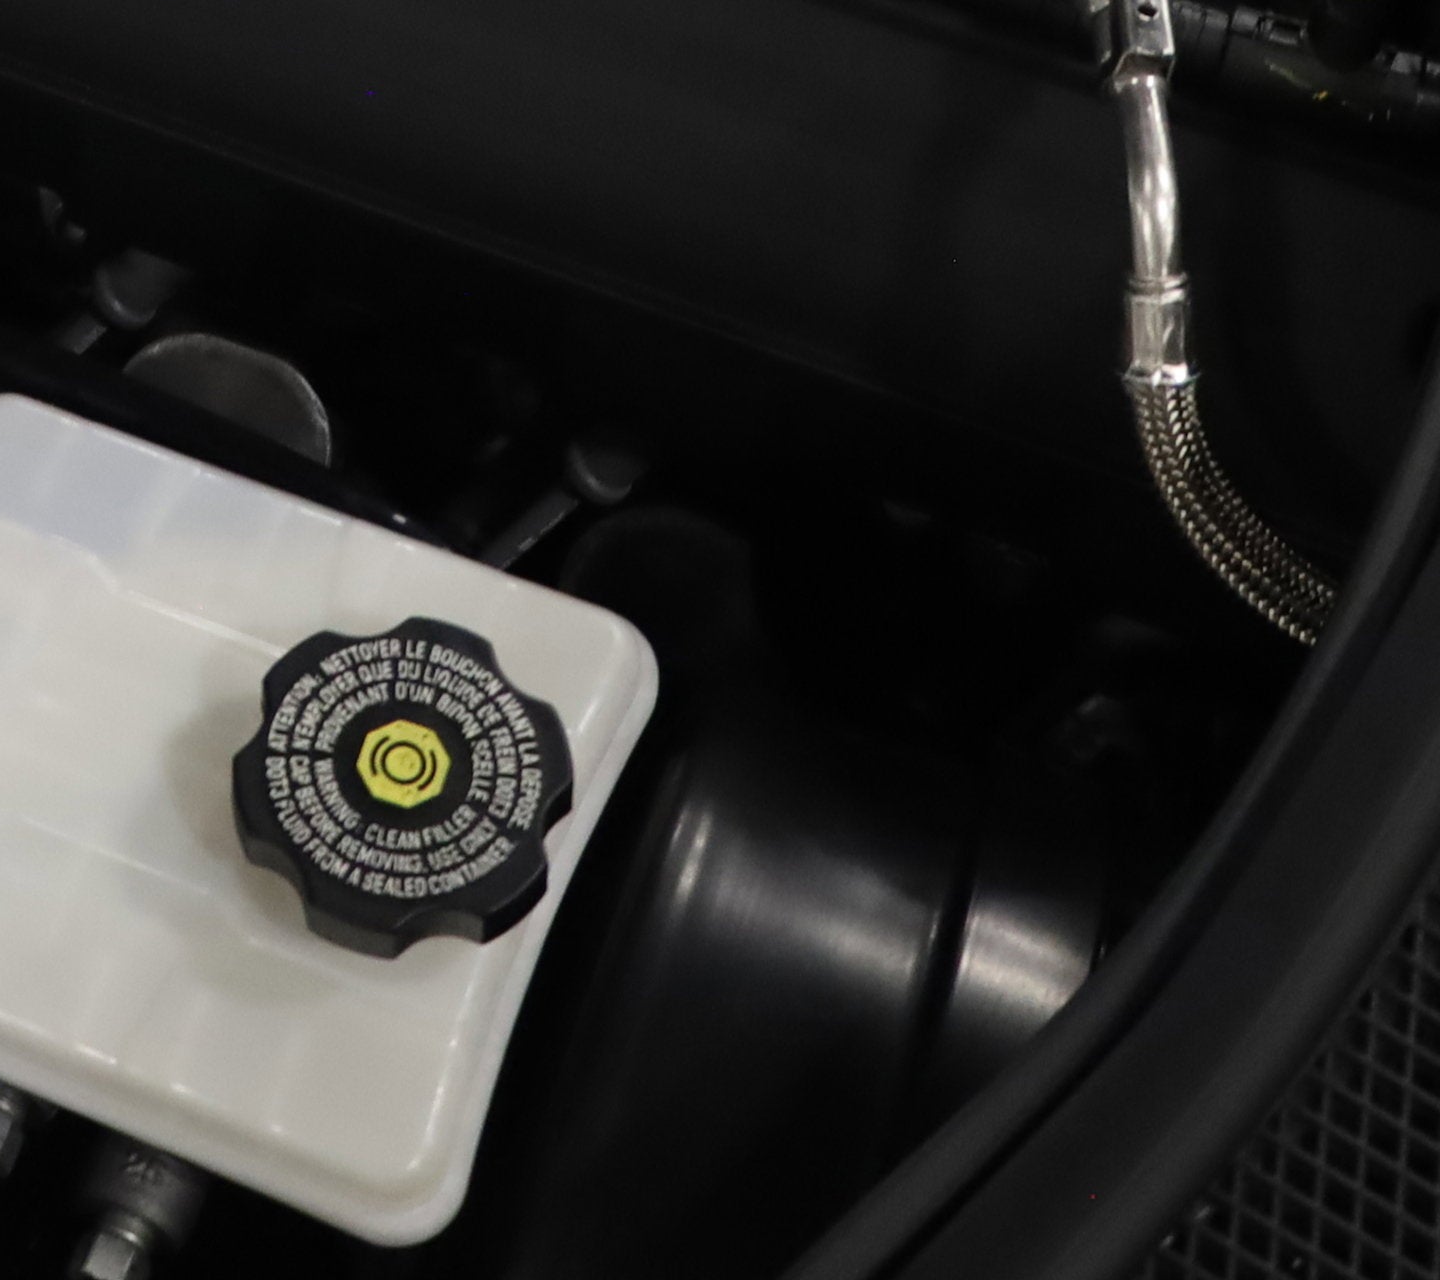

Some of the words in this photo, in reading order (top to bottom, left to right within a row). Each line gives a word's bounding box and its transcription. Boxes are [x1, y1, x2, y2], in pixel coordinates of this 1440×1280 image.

[357, 659, 394, 684] QUE
[397, 660, 422, 680] DU
[423, 664, 487, 710] LIQUIDE
[394, 680, 435, 705] D'UN
[405, 638, 428, 659] LE
[429, 643, 504, 697] BOUCHON
[496, 692, 536, 738] AVANT
[518, 741, 541, 766] LA
[476, 702, 503, 729] DE
[489, 725, 518, 776] FREIN
[264, 754, 291, 799] DOT3
[289, 754, 313, 786] CAP
[273, 797, 313, 846] FLUID
[293, 784, 343, 846] BEFORE
[365, 822, 423, 851] CLEAN
[422, 803, 478, 847] FILLER
[302, 836, 351, 880] FROM
[426, 842, 466, 873] USE
[345, 866, 362, 888] A
[361, 869, 428, 900] SEALED
